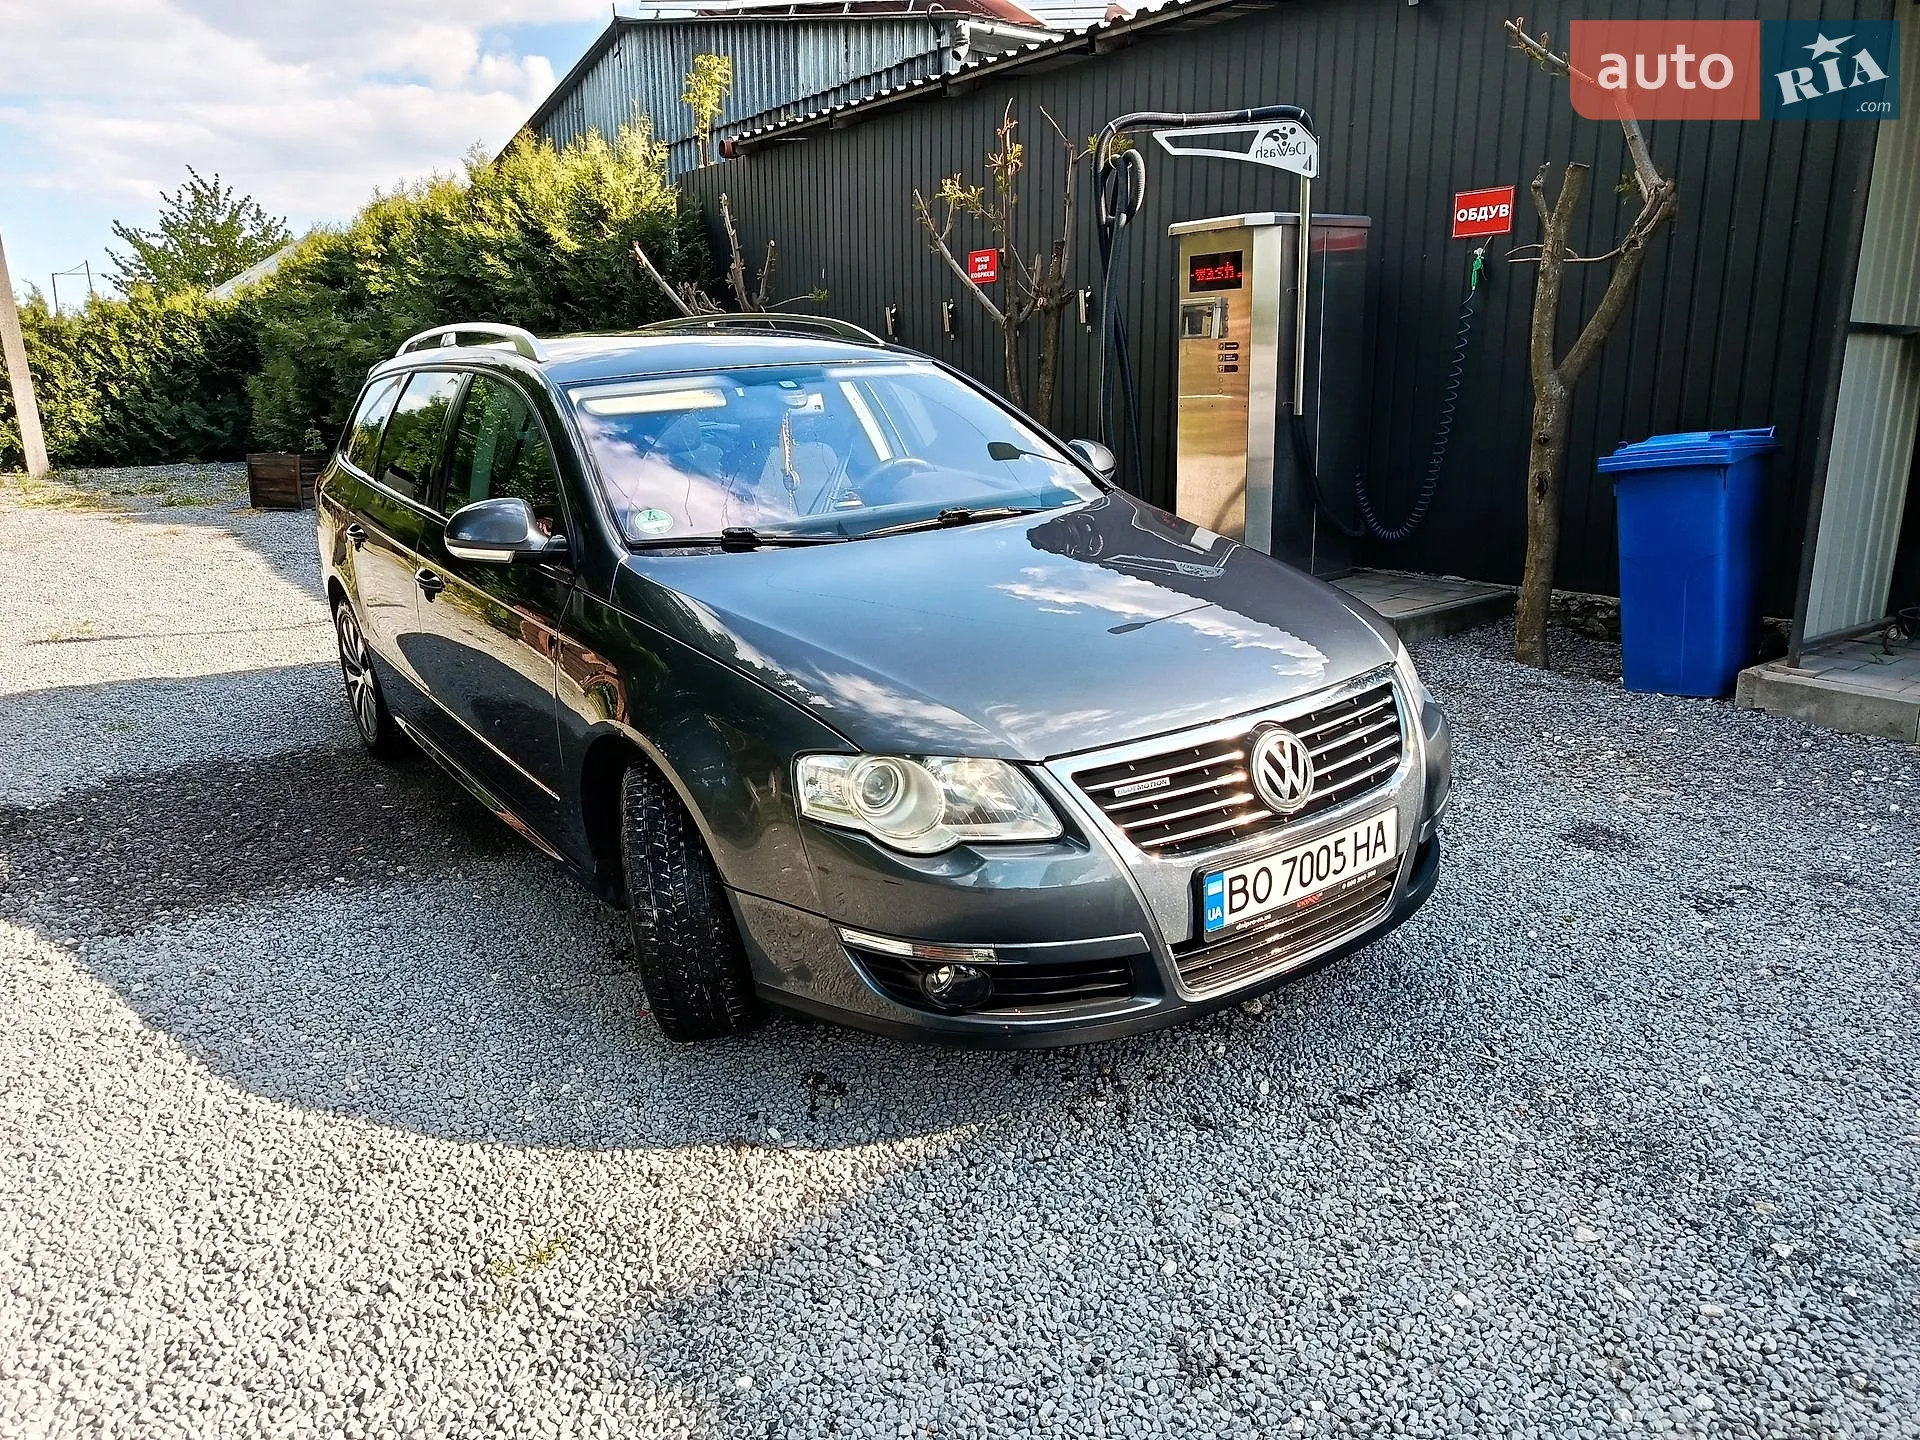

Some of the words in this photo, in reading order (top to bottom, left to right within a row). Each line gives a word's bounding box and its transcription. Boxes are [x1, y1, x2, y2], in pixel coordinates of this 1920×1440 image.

[1456, 203, 1510, 223] ОБДУВ
[1228, 866, 1273, 915] BO
[1281, 837, 1347, 897] 7005
[1352, 820, 1387, 868] HA
[1207, 906, 1223, 922] UA
